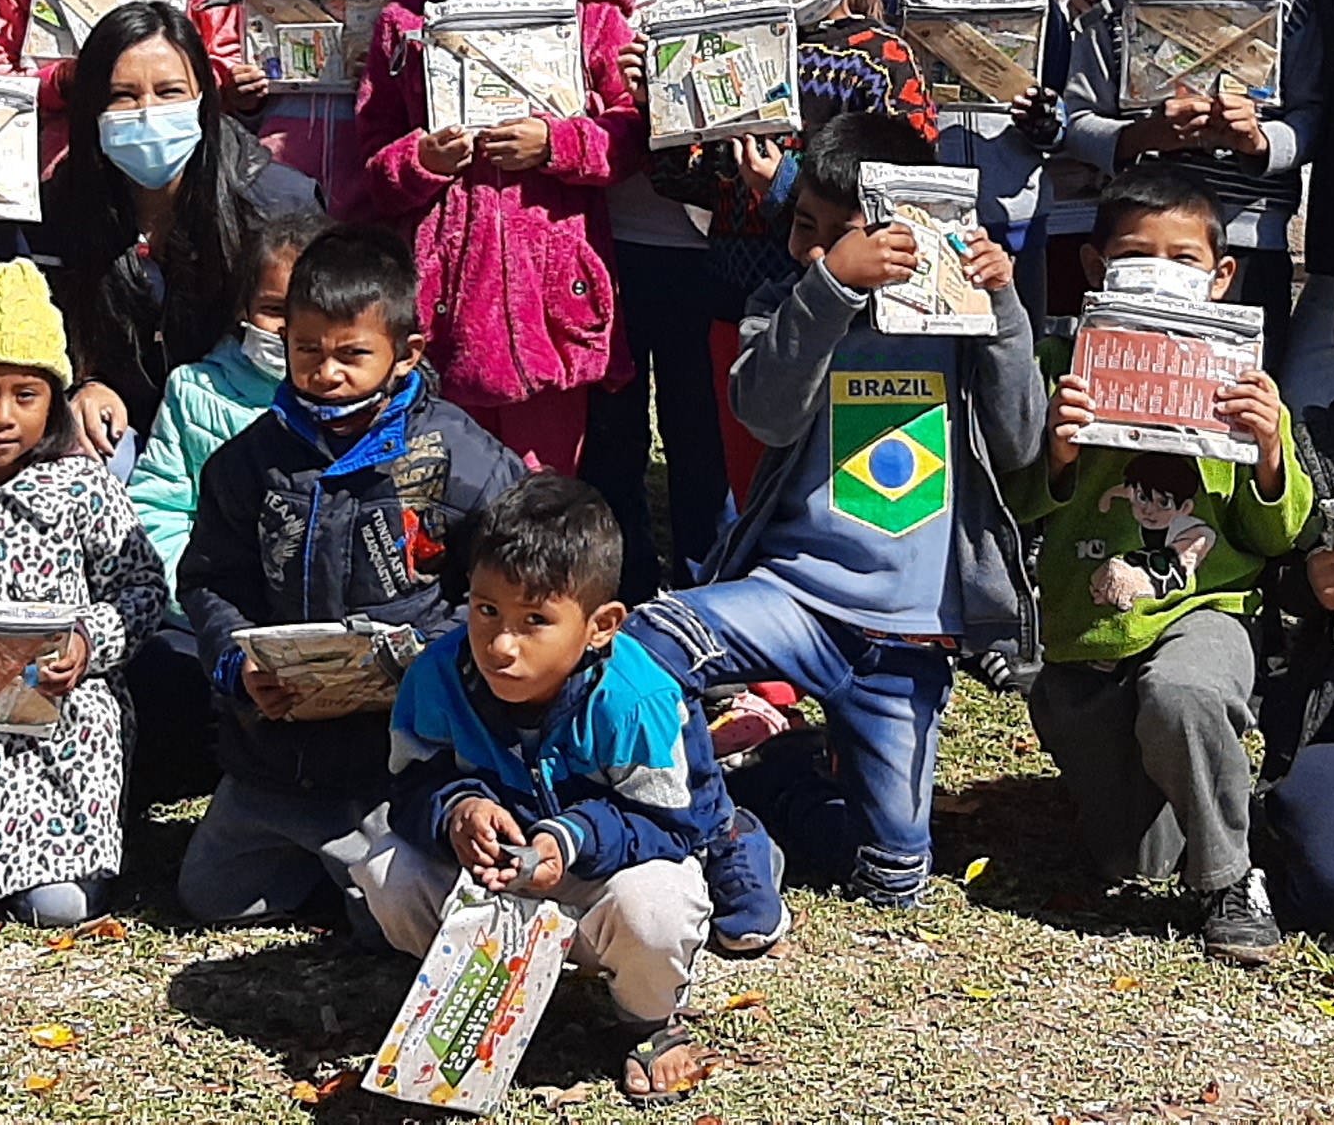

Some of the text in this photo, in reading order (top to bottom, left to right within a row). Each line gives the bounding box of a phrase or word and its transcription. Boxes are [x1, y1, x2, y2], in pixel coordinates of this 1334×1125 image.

[846, 377, 934, 398] BRAZIL
[432, 980, 469, 1035] Amor
[443, 1050, 460, 1070] La
